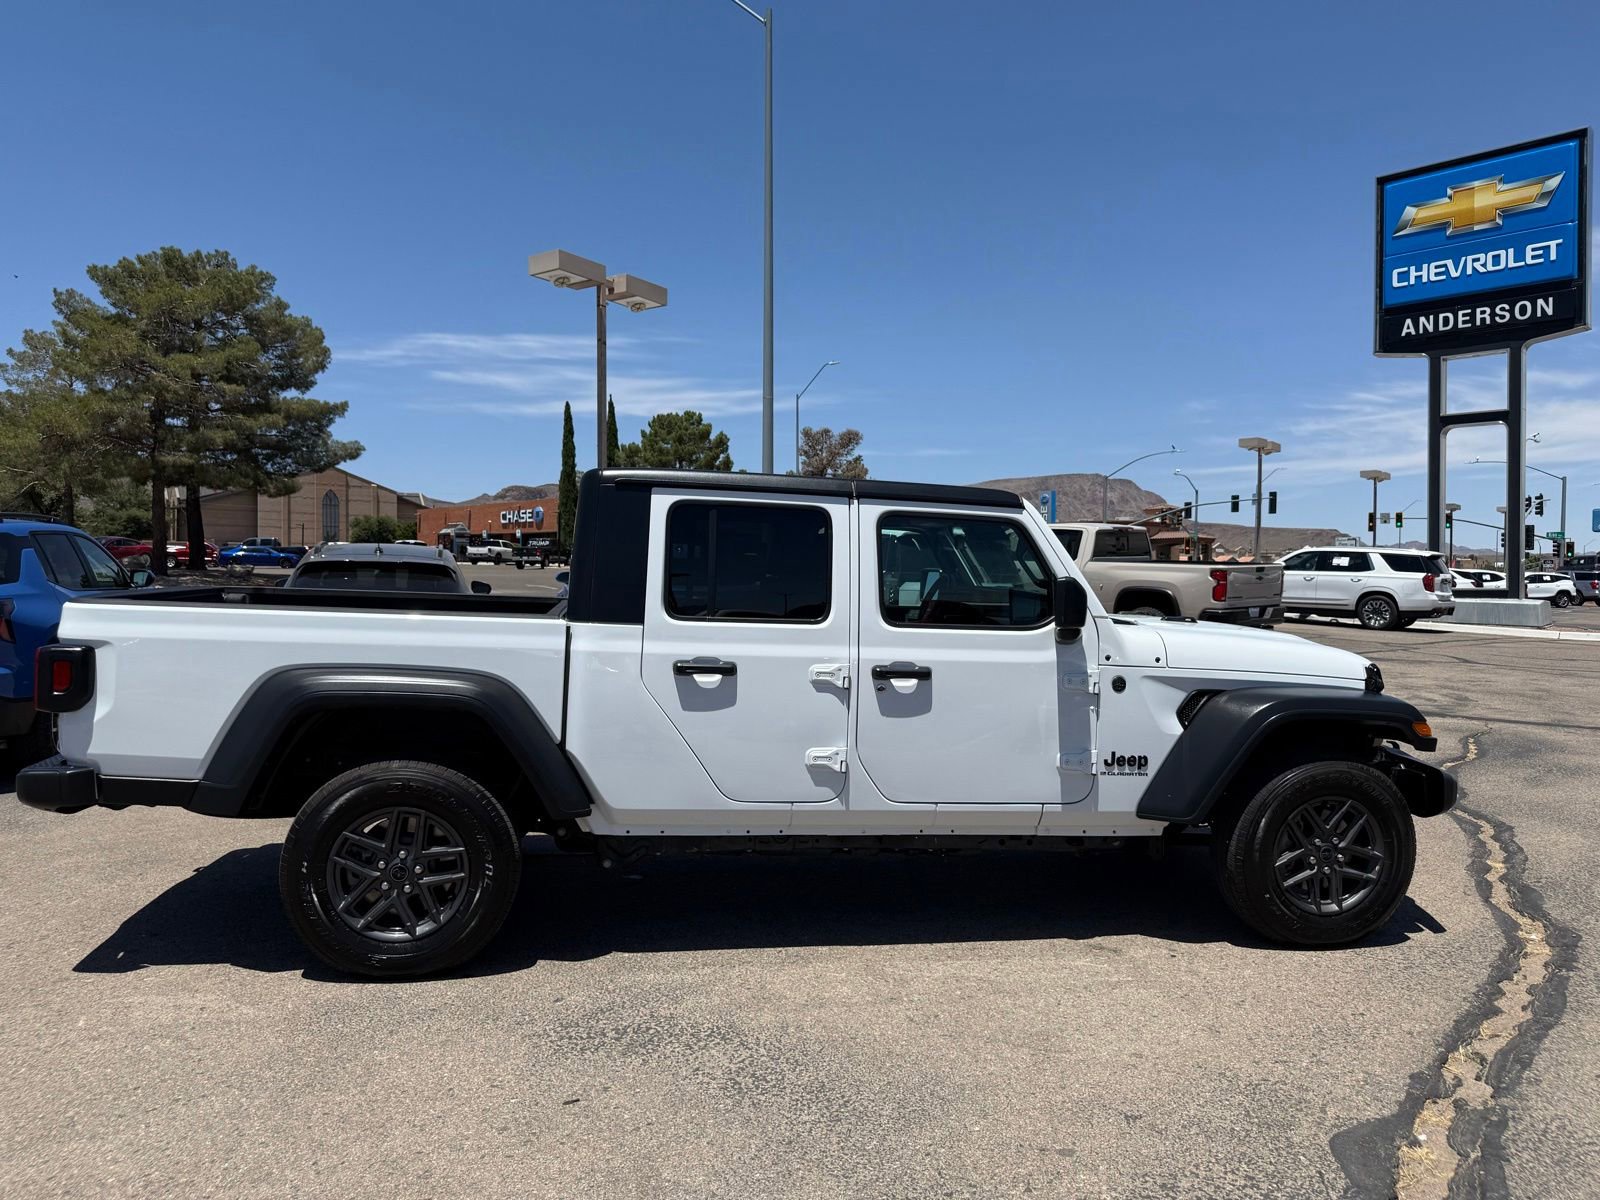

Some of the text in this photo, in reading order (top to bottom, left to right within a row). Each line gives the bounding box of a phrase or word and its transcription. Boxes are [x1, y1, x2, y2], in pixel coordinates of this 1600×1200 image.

[1392, 238, 1563, 288] CHEVROLET
[1401, 297, 1554, 337] ANDERSON
[501, 509, 534, 524] CHASE
[1103, 751, 1149, 770] Jeep
